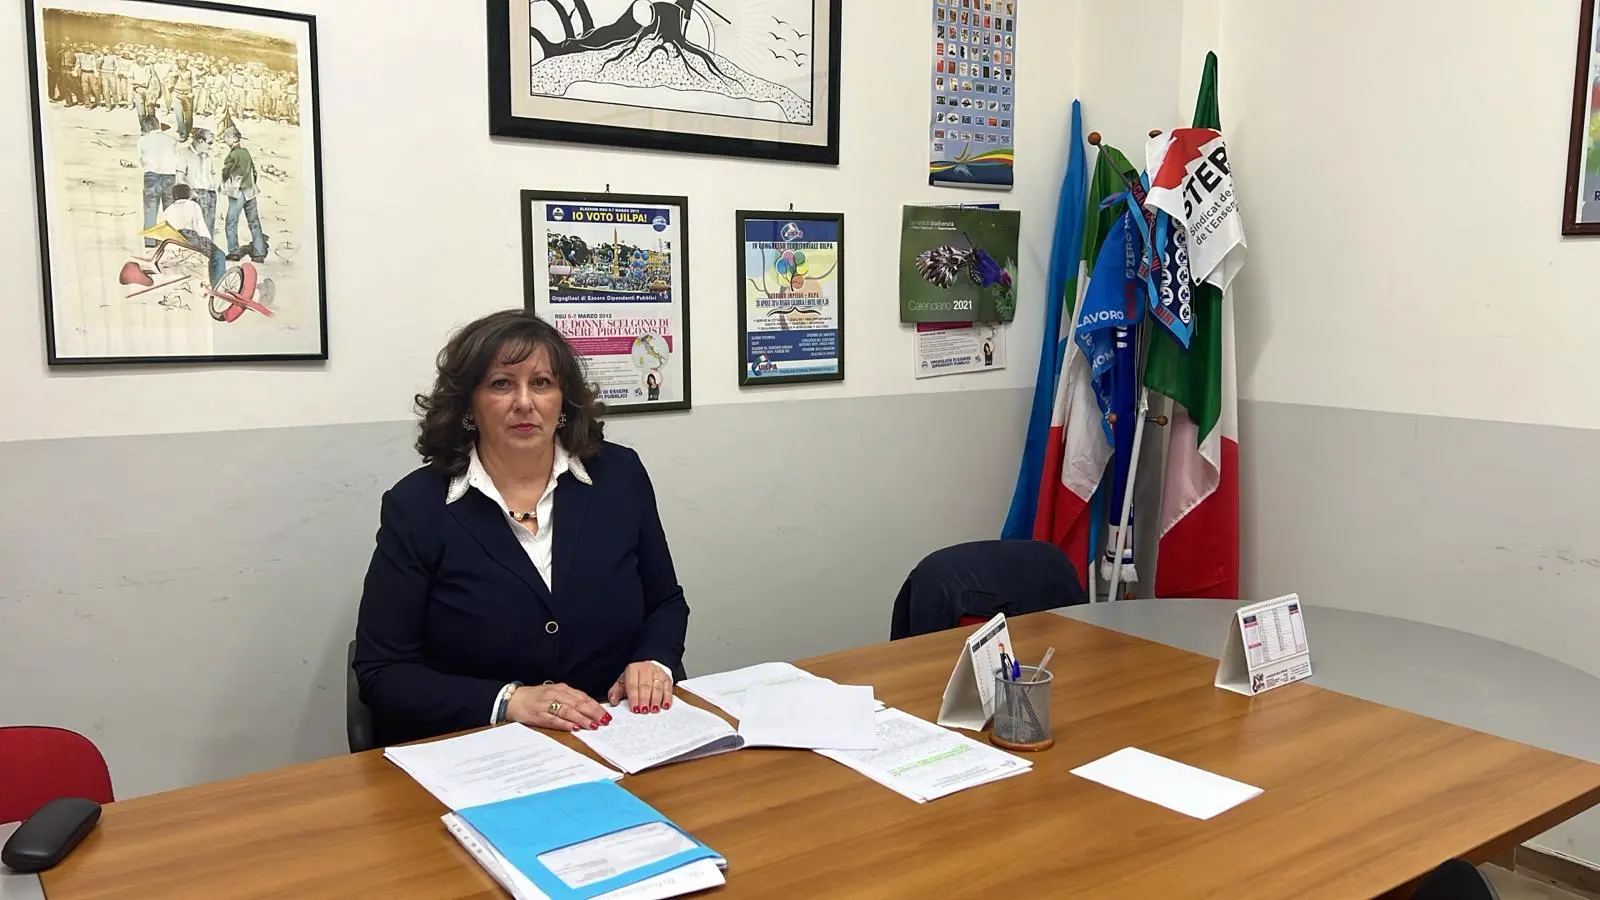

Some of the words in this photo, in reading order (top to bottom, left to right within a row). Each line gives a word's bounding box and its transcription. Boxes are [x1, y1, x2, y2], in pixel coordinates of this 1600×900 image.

[572, 211, 584, 221] IO
[586, 211, 614, 222] VOTO
[616, 213, 647, 223] UILPA!
[1190, 201, 1221, 237] Sindicat
[1219, 188, 1232, 203] de
[1196, 232, 1208, 246] de
[1124, 235, 1136, 267] ZERO
[908, 299, 952, 311] Calendario
[953, 299, 972, 310] 2021
[571, 319, 605, 328] DONNE
[608, 318, 658, 328] SCELGONO
[660, 318, 669, 327] DI
[562, 327, 596, 336] SSERE
[598, 326, 670, 336] PROTAGONISTE
